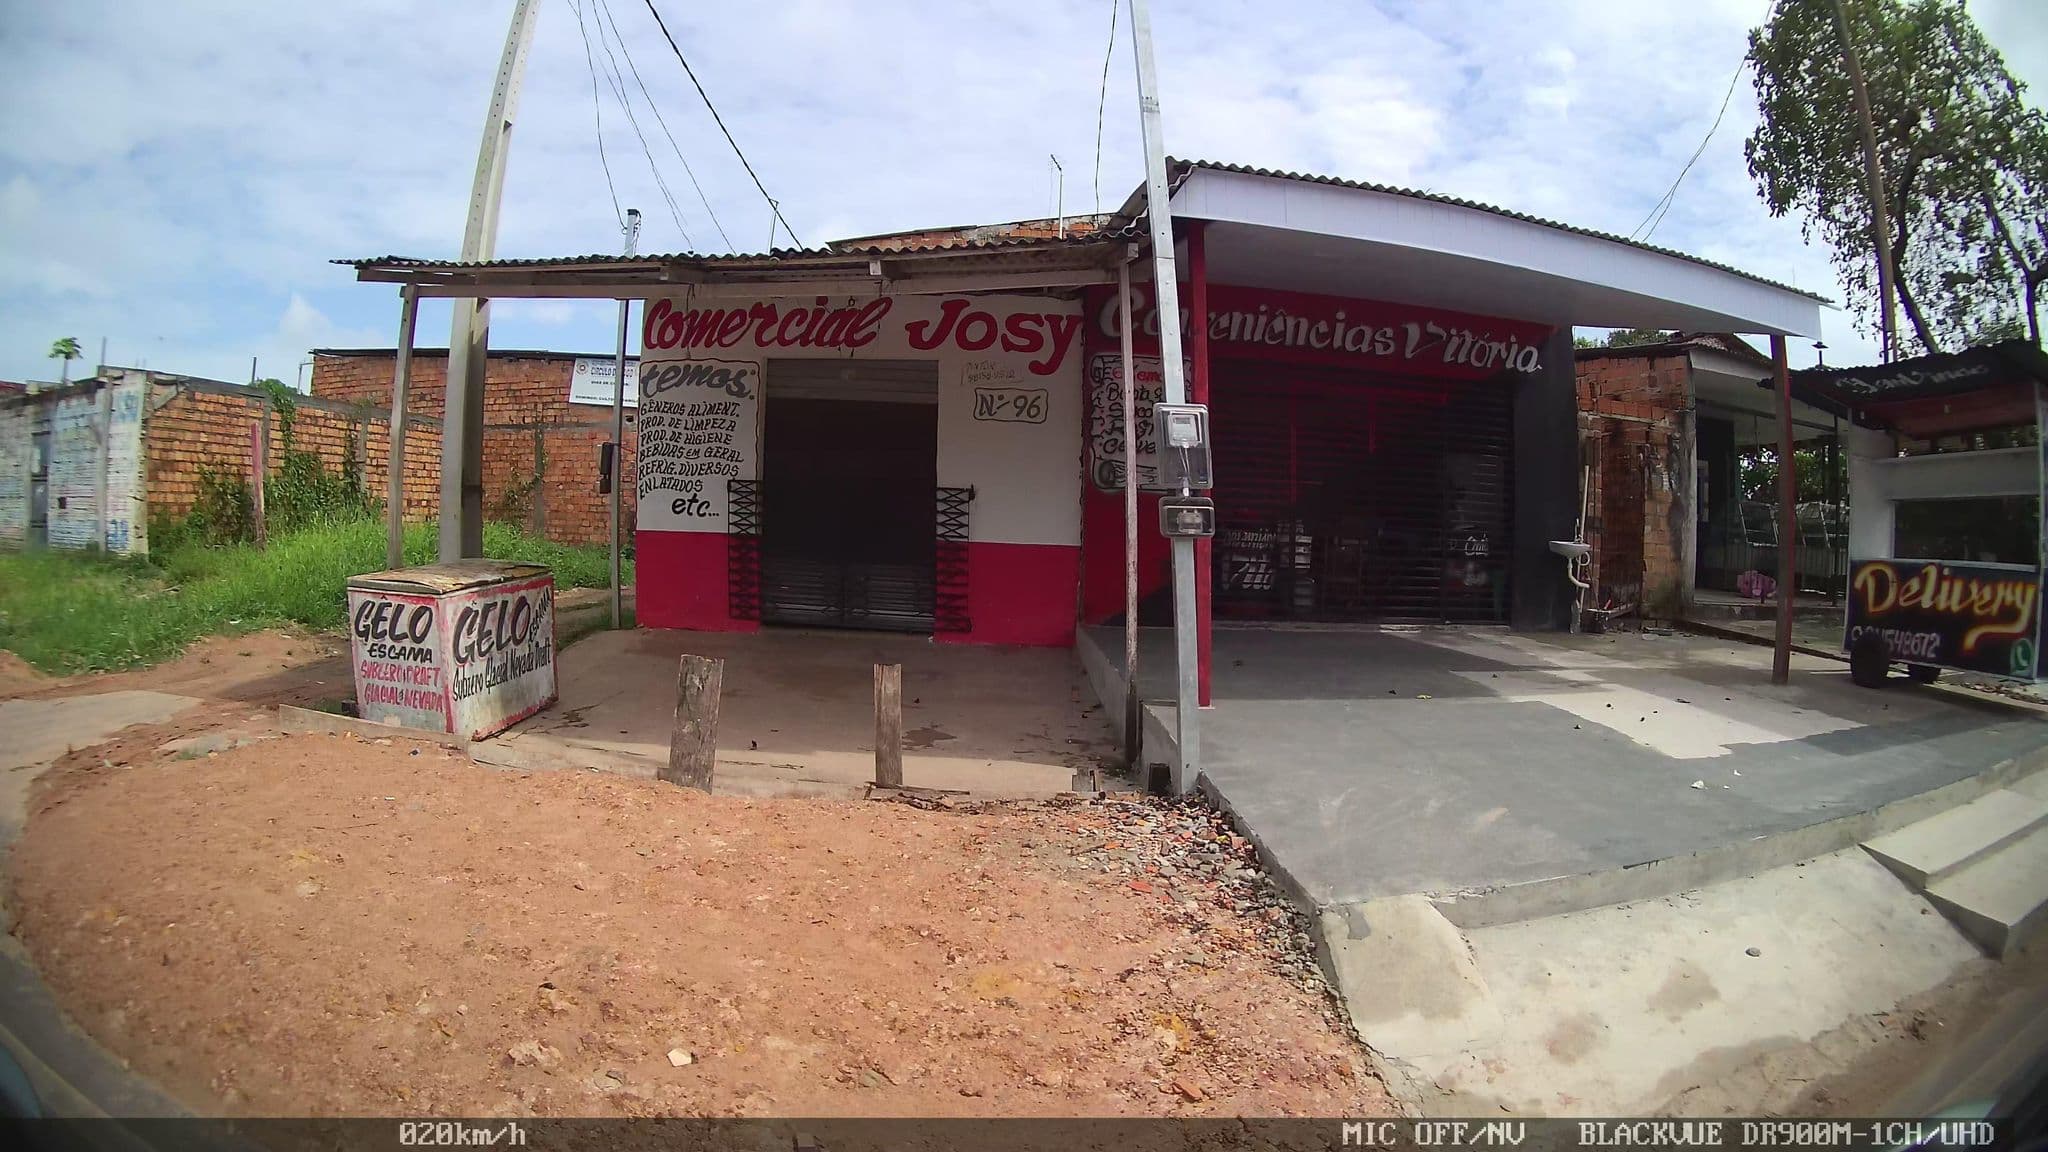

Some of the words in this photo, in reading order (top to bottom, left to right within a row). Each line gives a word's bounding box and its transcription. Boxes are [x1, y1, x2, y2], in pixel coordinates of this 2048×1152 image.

[643, 296, 893, 352] Comercial
[905, 299, 1083, 376] Josy
[1013, 395, 1041, 418] 96
[640, 416, 666, 432] PROD.
[668, 417, 682, 429] DE
[684, 417, 736, 432] LIMPEZA
[640, 430, 668, 447] PROD.
[669, 431, 682, 444] DE
[684, 432, 733, 445] HIGIENE
[639, 441, 685, 463] BEBIDAS
[685, 448, 700, 459] EM
[703, 447, 744, 463] GERAL
[639, 459, 677, 480] REFRIG.
[677, 461, 740, 477] DIVERSOS
[638, 476, 703, 500] ENLATADOS
[1854, 561, 2036, 652] Delivery
[367, 643, 433, 664] ESCAMA
[453, 665, 484, 702] Subzero
[511, 640, 534, 680] Nevada
[404, 689, 443, 713] NEVADA
